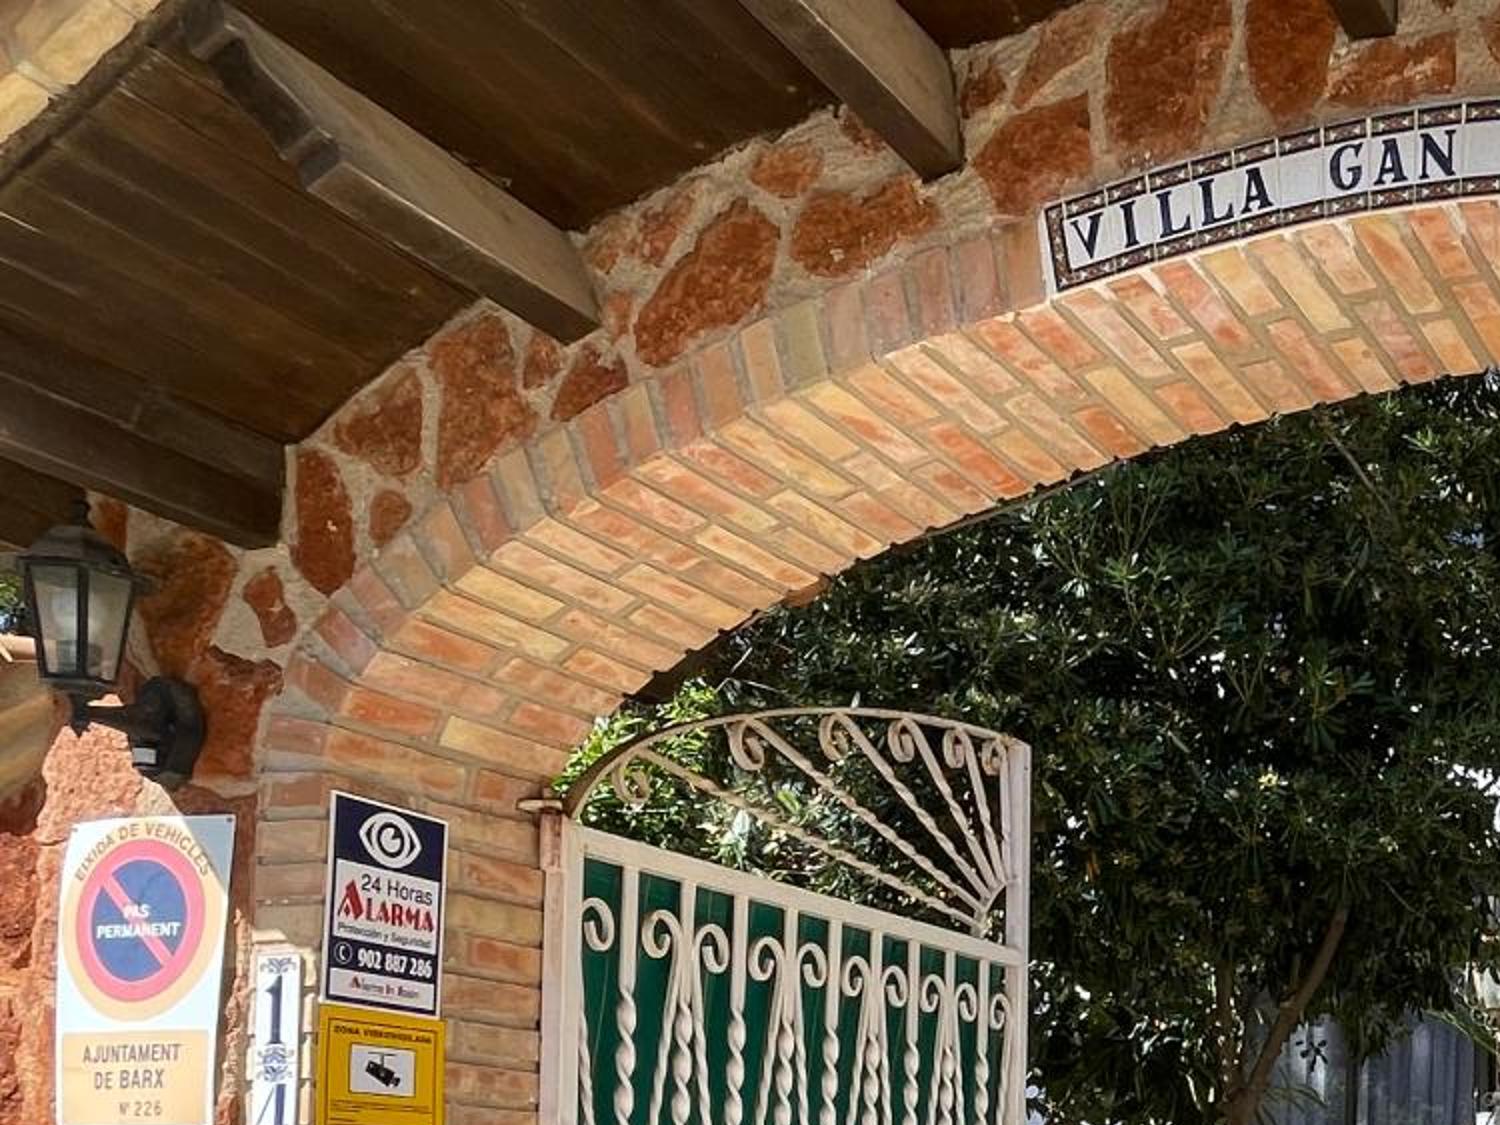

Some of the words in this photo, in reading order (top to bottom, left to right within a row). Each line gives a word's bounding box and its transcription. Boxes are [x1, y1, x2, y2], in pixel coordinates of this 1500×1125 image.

[1070, 167, 1274, 260] VILLA
[1329, 129, 1457, 190] GAN
[118, 823, 141, 840] DE
[144, 822, 211, 877] VEHICLES
[361, 874, 381, 892] 24
[387, 879, 433, 905] Horas
[338, 879, 435, 932] ALARMA
[96, 922, 181, 939] PERMANENT
[357, 948, 381, 970] 902
[384, 953, 407, 974] 887
[409, 958, 433, 979] 286
[83, 1043, 181, 1063] AJUNTAMENT
[94, 1071, 114, 1089] DE
[119, 1069, 166, 1089] BARX
[134, 1101, 163, 1116] 226
